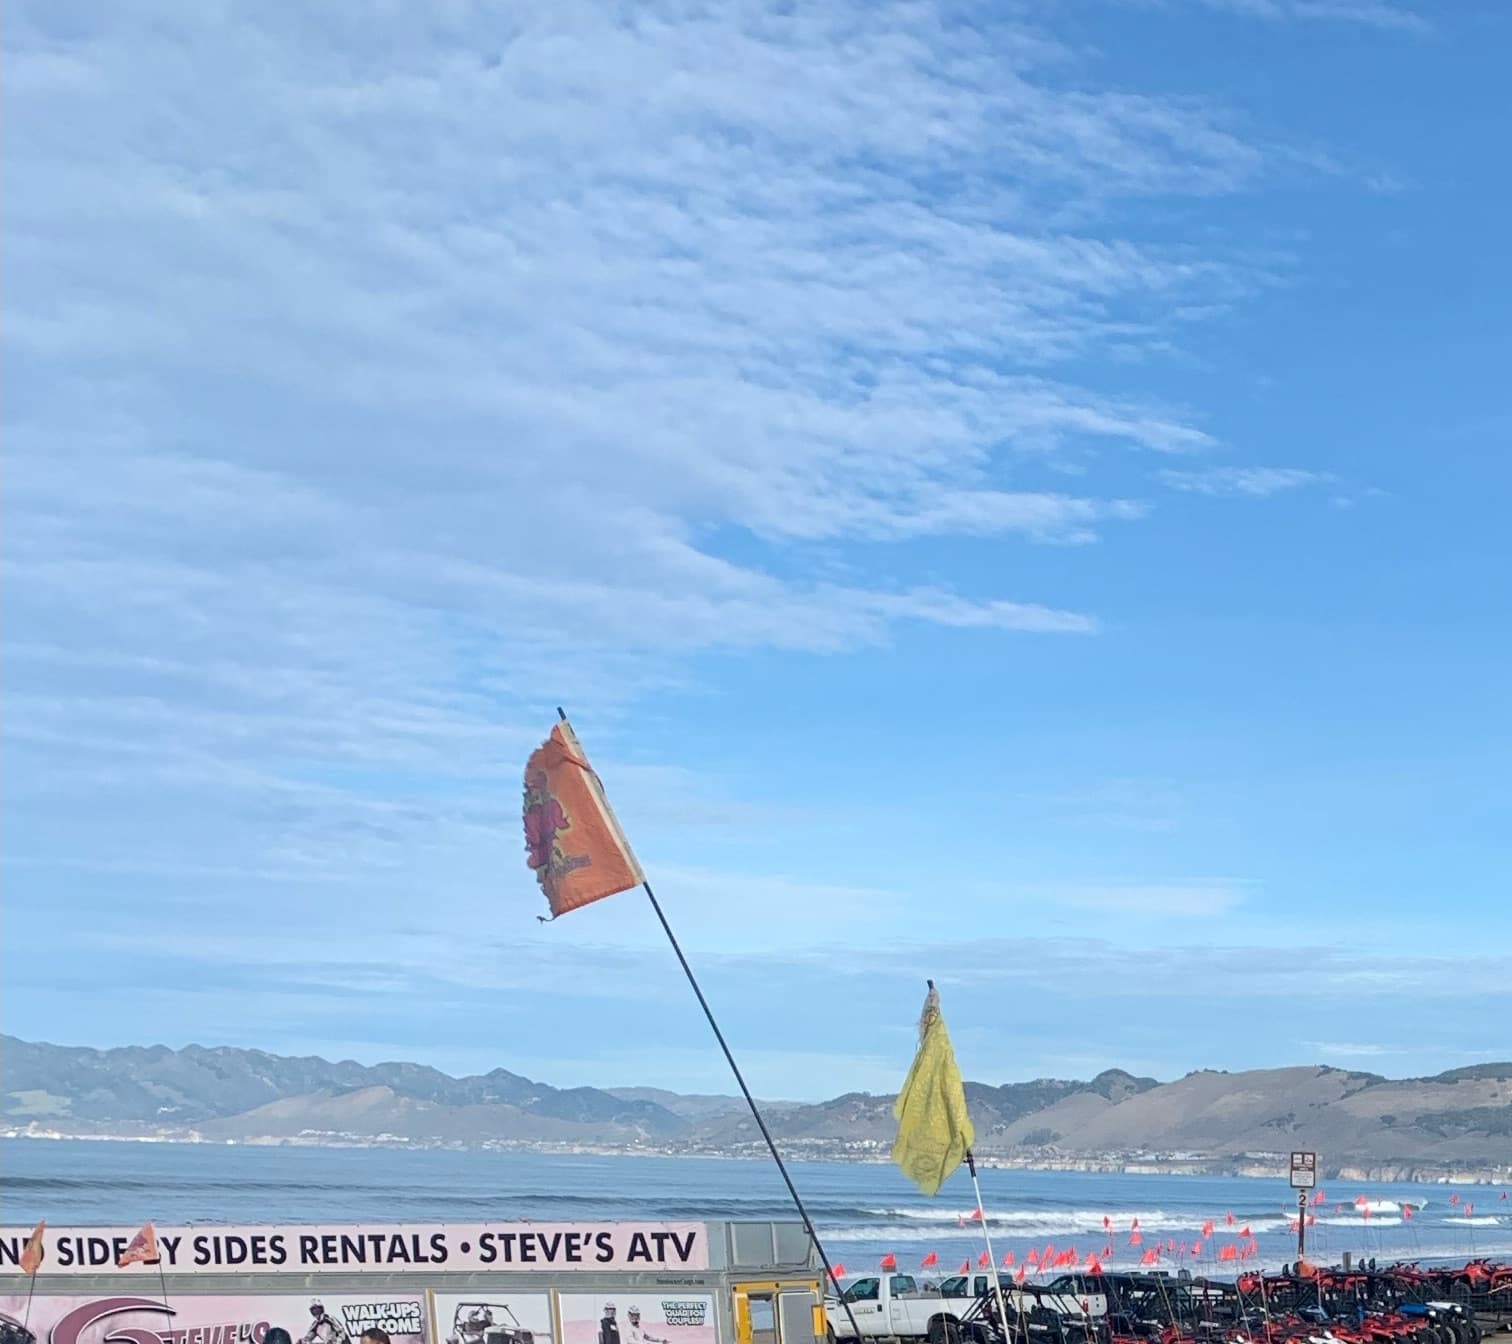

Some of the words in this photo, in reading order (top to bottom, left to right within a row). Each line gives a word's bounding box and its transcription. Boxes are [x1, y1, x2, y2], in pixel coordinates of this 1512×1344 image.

[1298, 1194, 1306, 1206] 2
[194, 1235, 287, 1265] SIDES
[300, 1234, 448, 1264] RENTALS
[480, 1232, 614, 1263] STEVE'S
[627, 1232, 697, 1262] ATV
[342, 1302, 421, 1321] WALK-UPS
[346, 1318, 421, 1337] WELCOME
